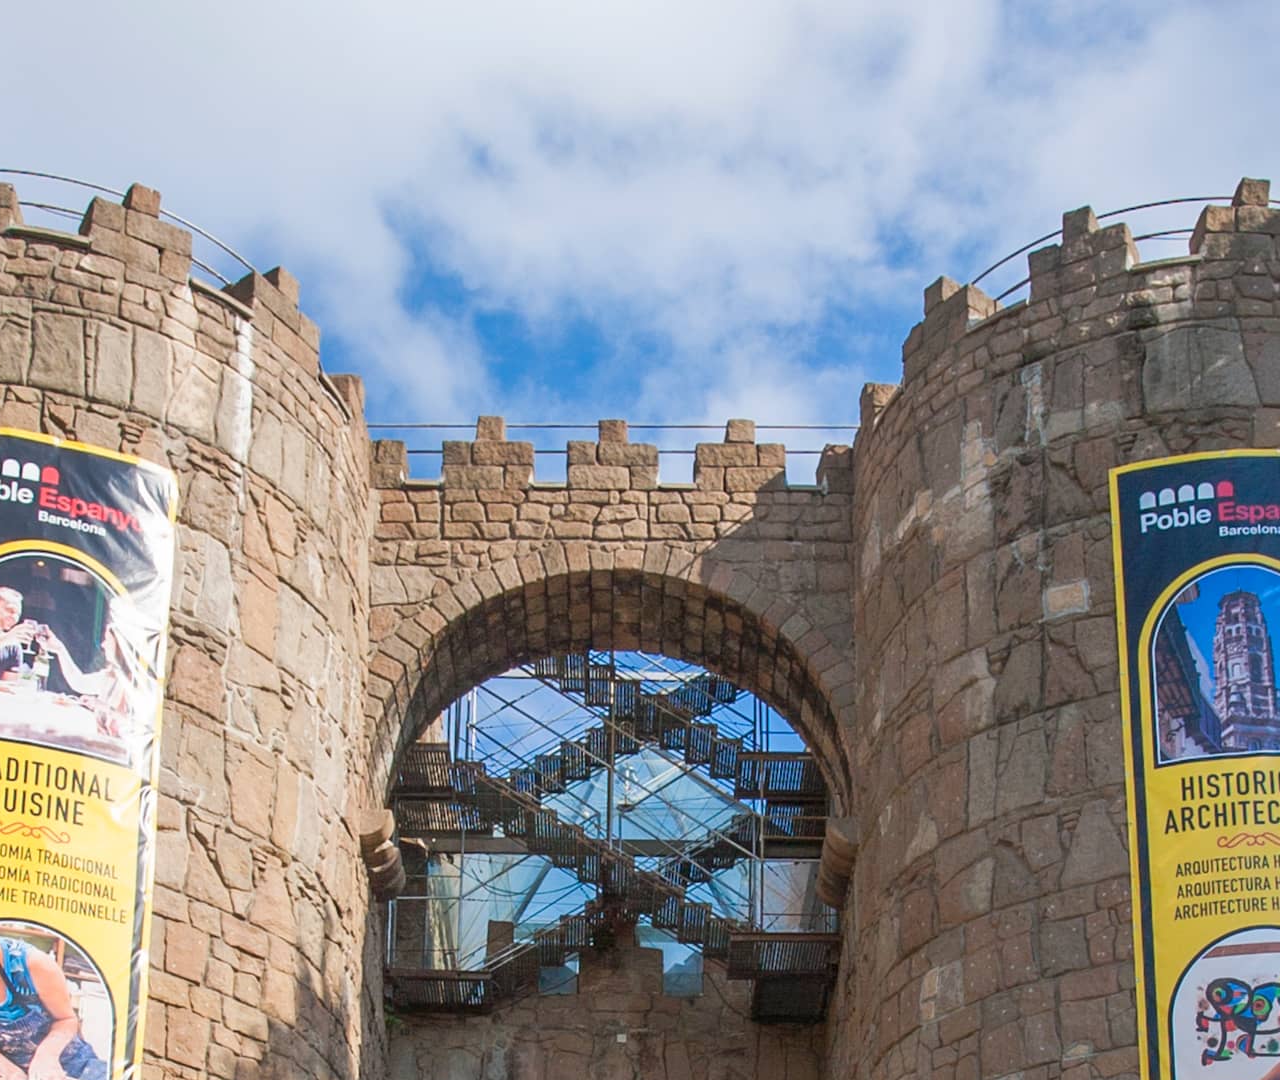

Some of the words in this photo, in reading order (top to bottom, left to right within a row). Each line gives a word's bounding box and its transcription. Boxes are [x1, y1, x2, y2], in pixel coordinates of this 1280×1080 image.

[38, 510, 106, 537] Barcelona
[1140, 505, 1212, 534] Poble
[37, 849, 118, 880] TRADICIONAL
[1175, 855, 1269, 878] ARQUITECTURA
[36, 871, 117, 902] TRADICIONAL
[1176, 877, 1270, 899] ARQUITECTURA
[22, 890, 127, 924] TRADITIONNELLE
[1174, 897, 1267, 920] ARCHITECTURE
